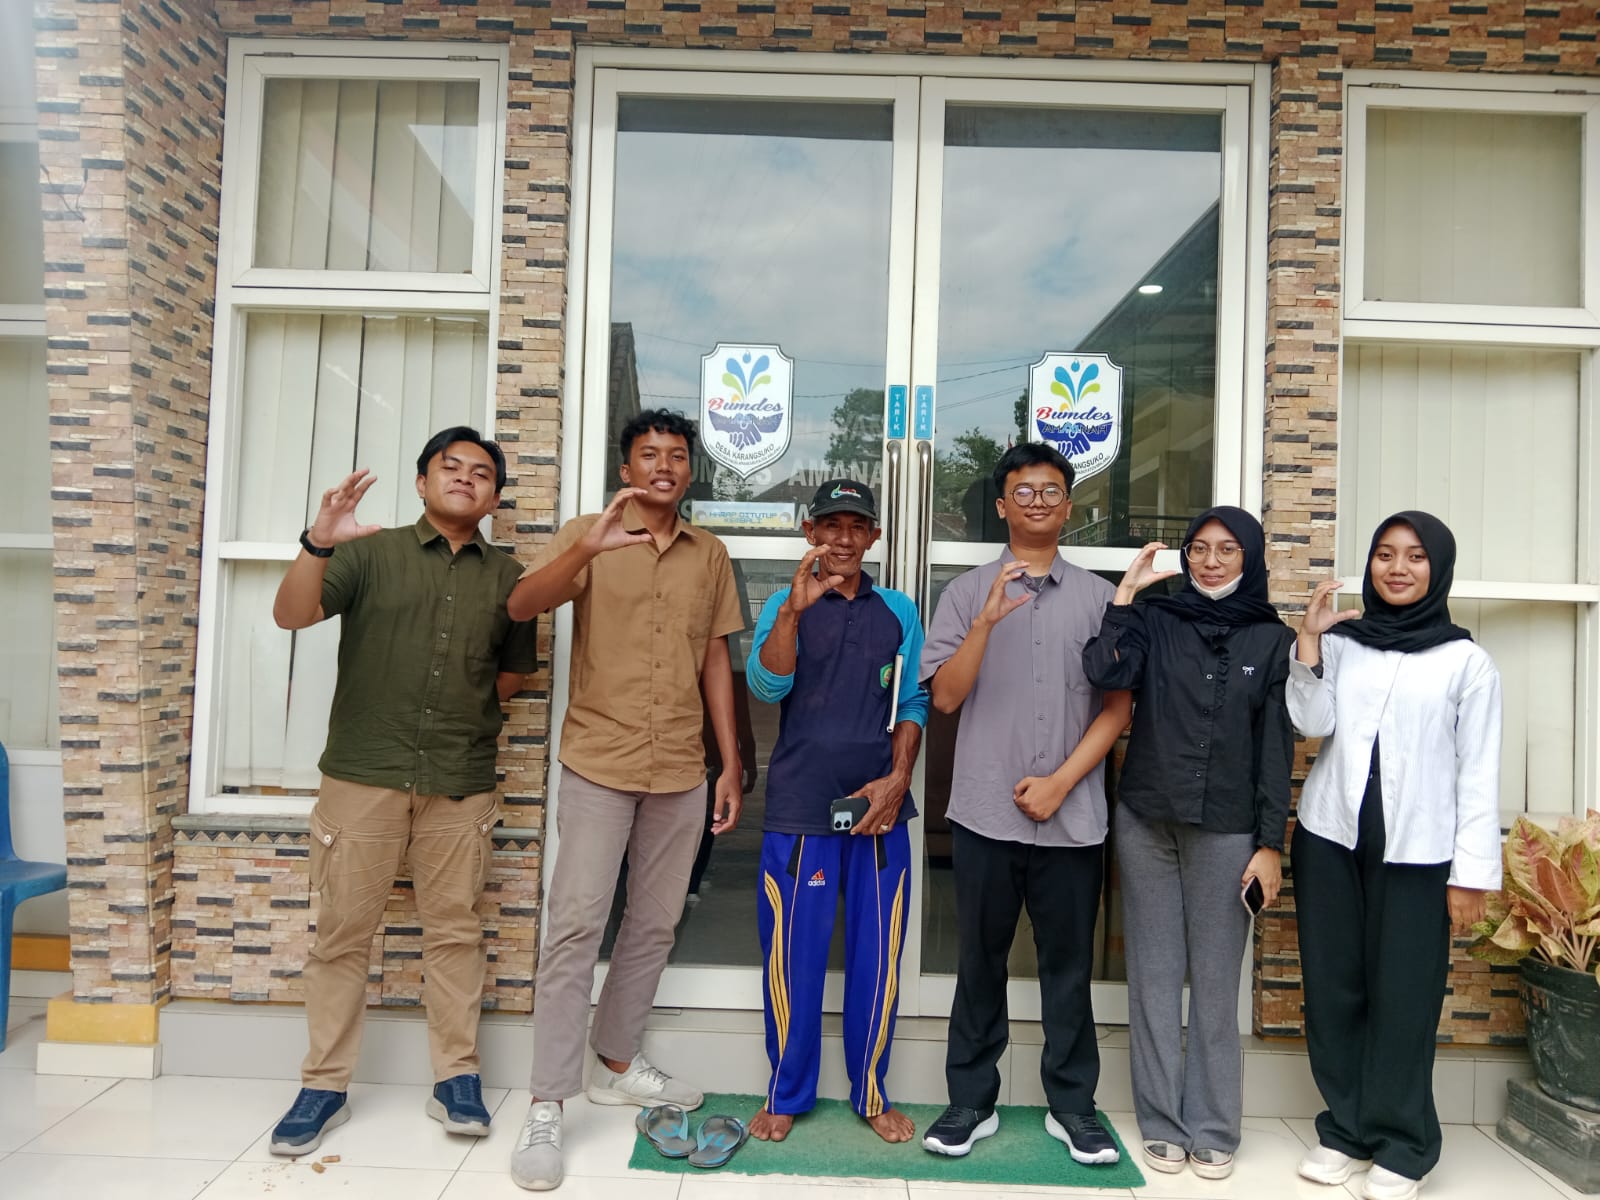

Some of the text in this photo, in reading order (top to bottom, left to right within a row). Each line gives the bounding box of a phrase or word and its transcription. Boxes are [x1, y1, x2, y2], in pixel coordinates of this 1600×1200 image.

[707, 397, 784, 412] Bumdes
[893, 393, 901, 431] TARIK
[919, 393, 928, 432] TARIK
[1036, 406, 1113, 420] Bumdes
[715, 441, 731, 457] DESA
[731, 443, 775, 462] KARANGSUKO
